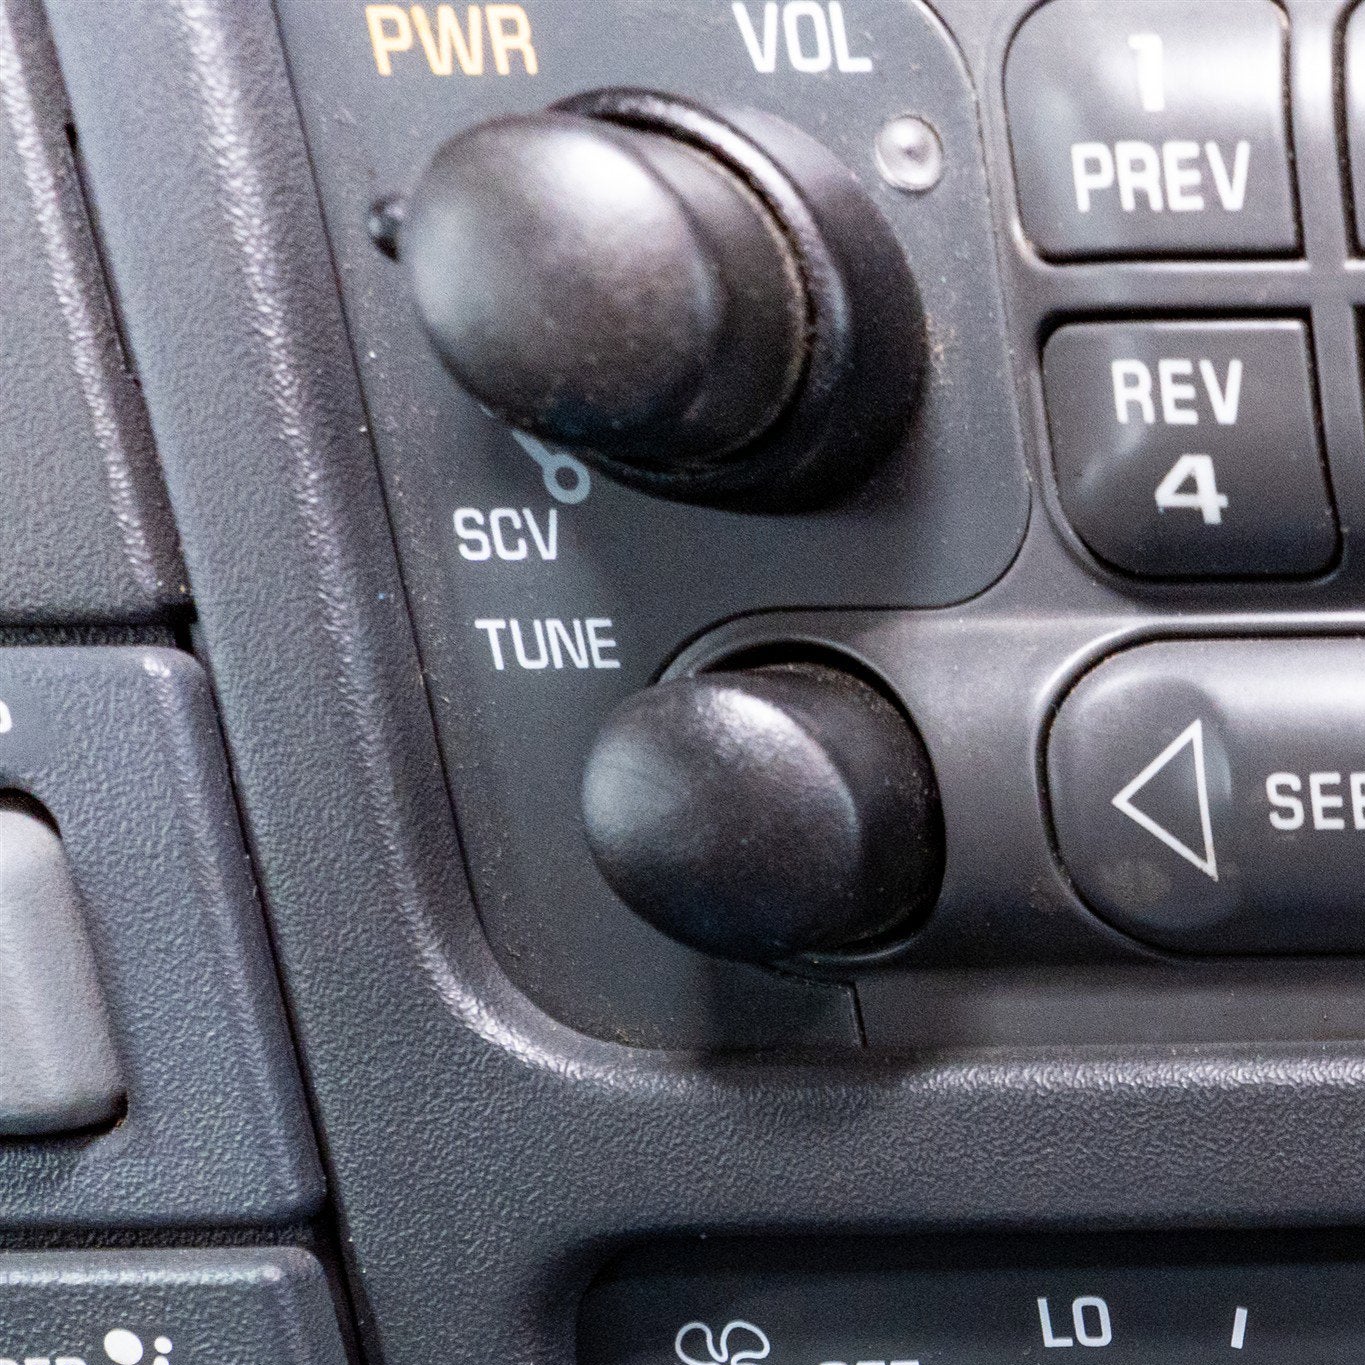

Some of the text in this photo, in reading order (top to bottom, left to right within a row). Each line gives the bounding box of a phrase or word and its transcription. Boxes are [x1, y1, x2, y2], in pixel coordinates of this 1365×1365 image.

[365, 4, 538, 76] PWR
[731, 0, 873, 74] VOL
[1127, 33, 1165, 112] 1
[1070, 140, 1251, 213] PREV
[1111, 358, 1242, 425] REV
[1155, 454, 1228, 524] 4
[453, 508, 557, 562] SCV
[474, 618, 620, 671] TUNE
[1037, 1296, 1113, 1348] LO
